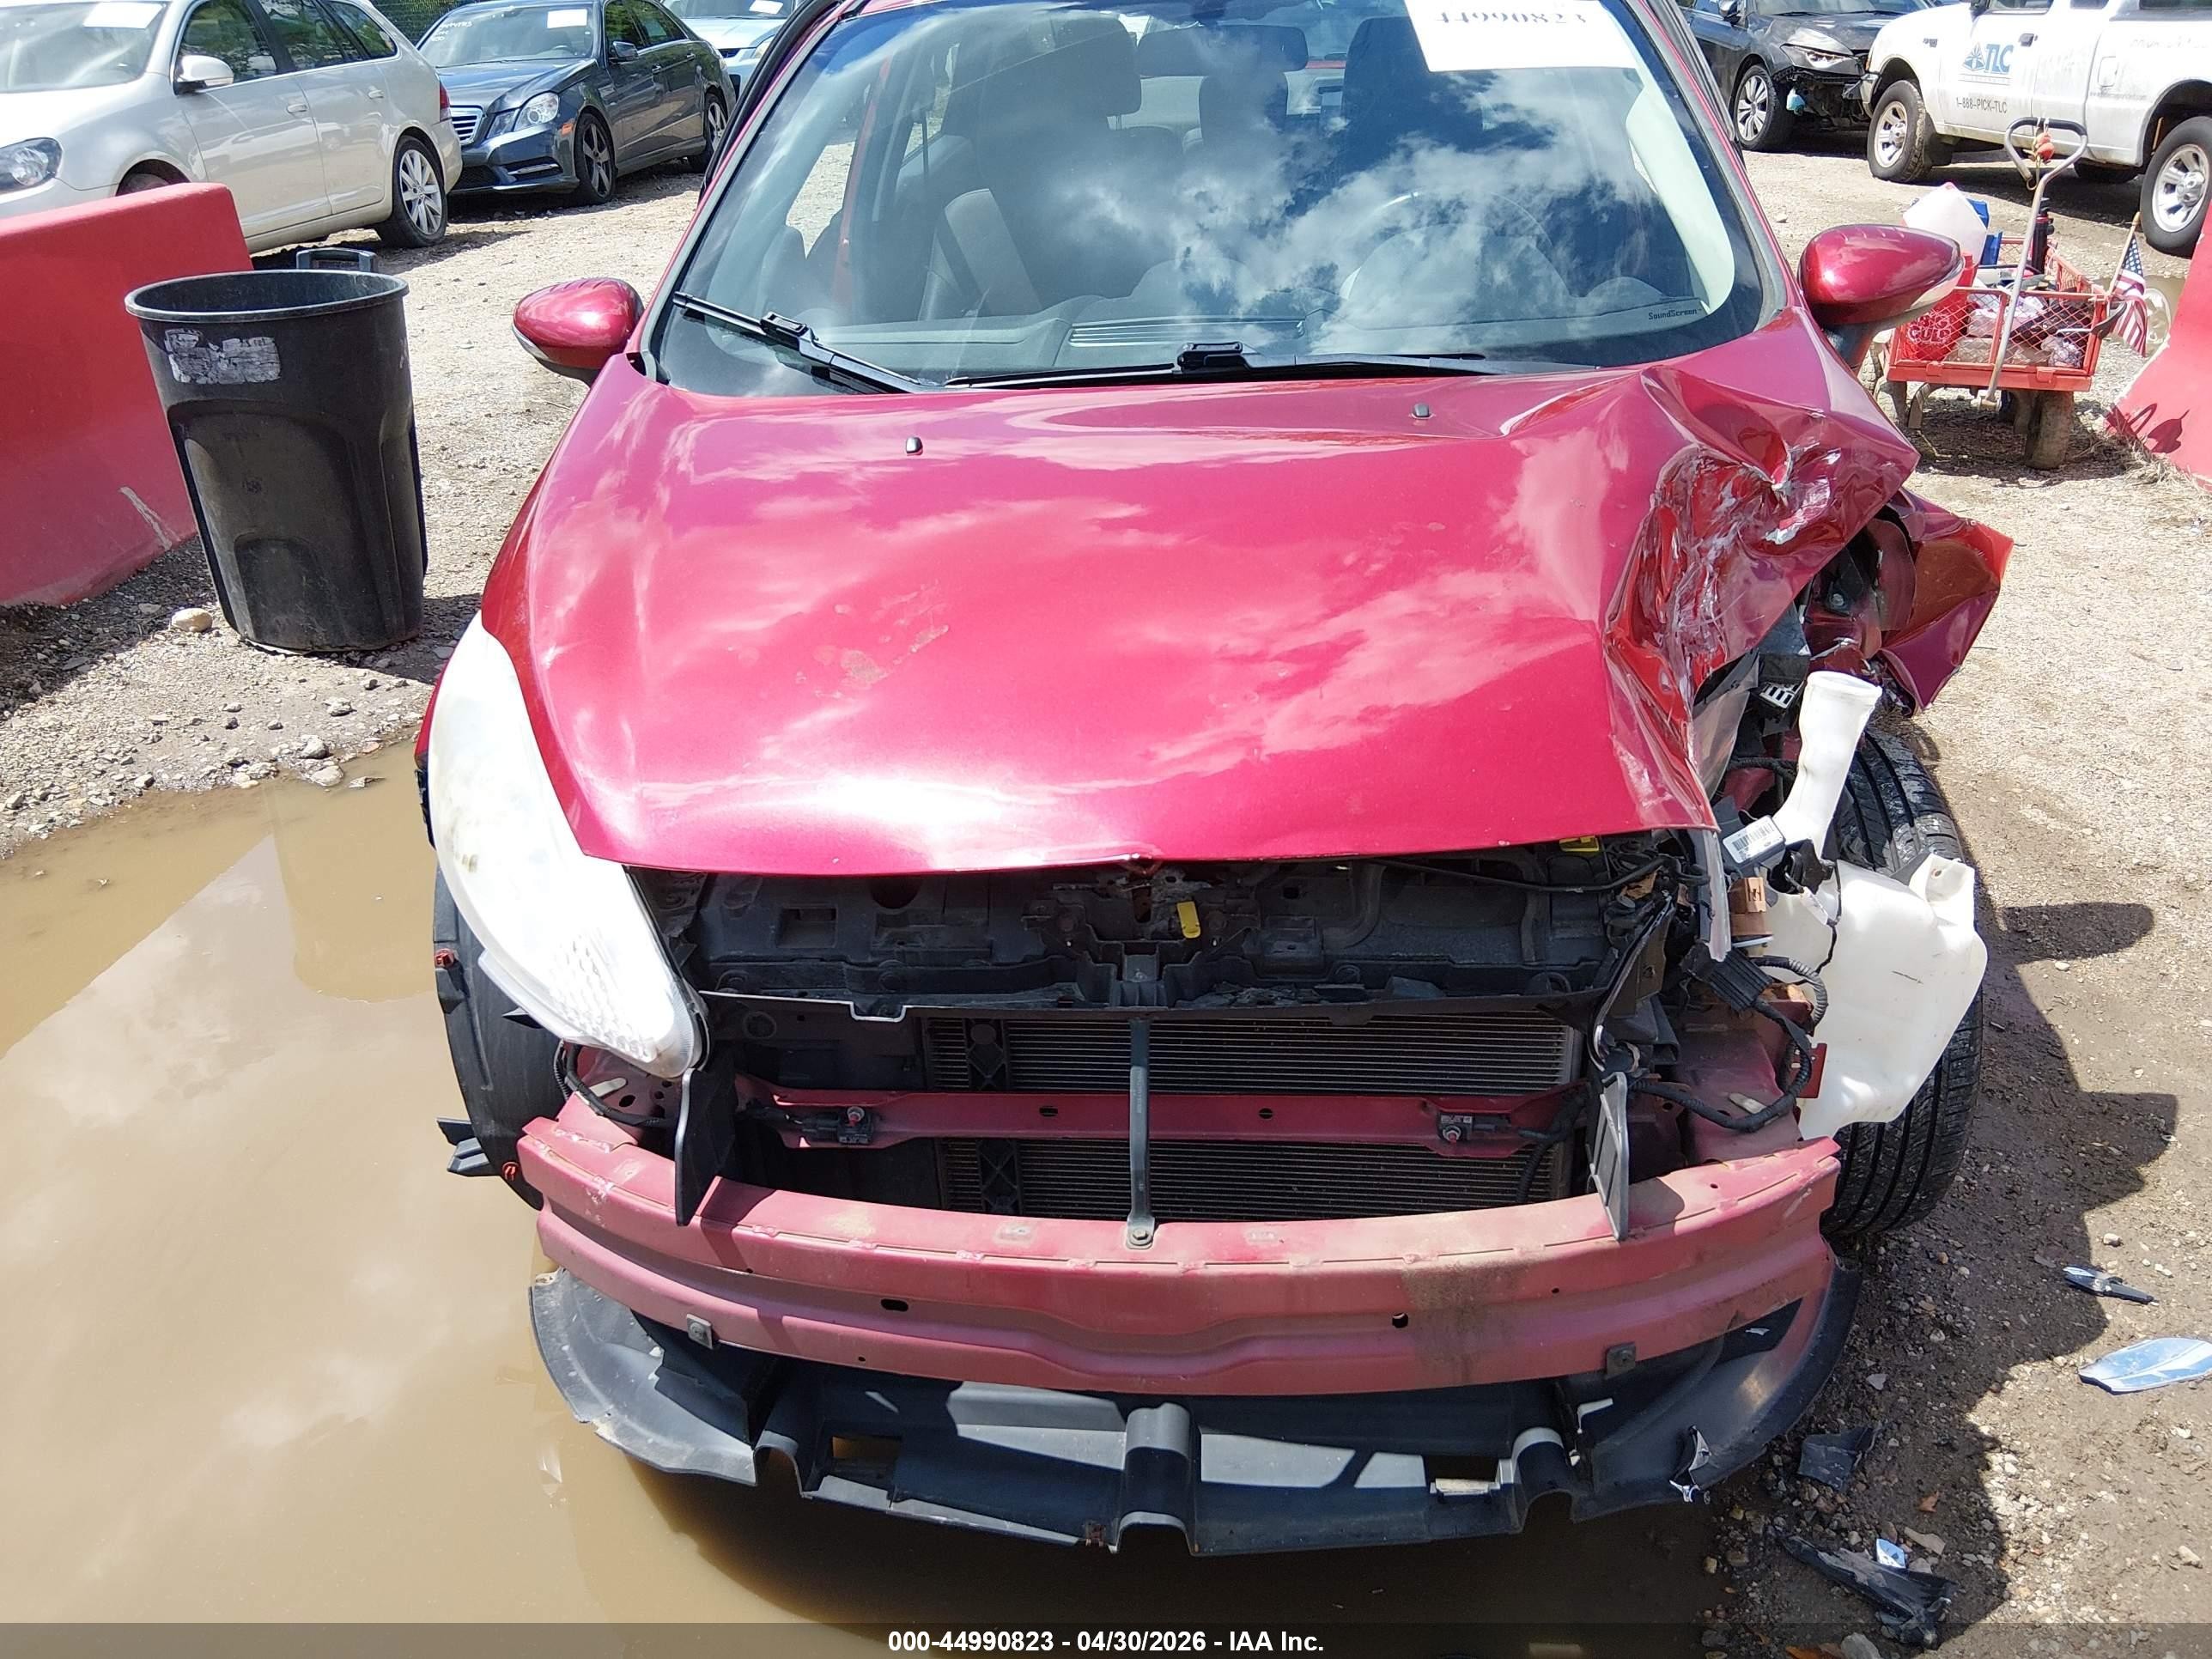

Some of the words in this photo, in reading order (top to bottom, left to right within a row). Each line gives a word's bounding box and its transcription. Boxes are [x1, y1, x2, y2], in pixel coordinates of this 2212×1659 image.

[1984, 44, 2014, 73] TLC
[1956, 97, 2008, 113] 1-888-PICK-TLC
[1648, 308, 1698, 320] SoundScreen
